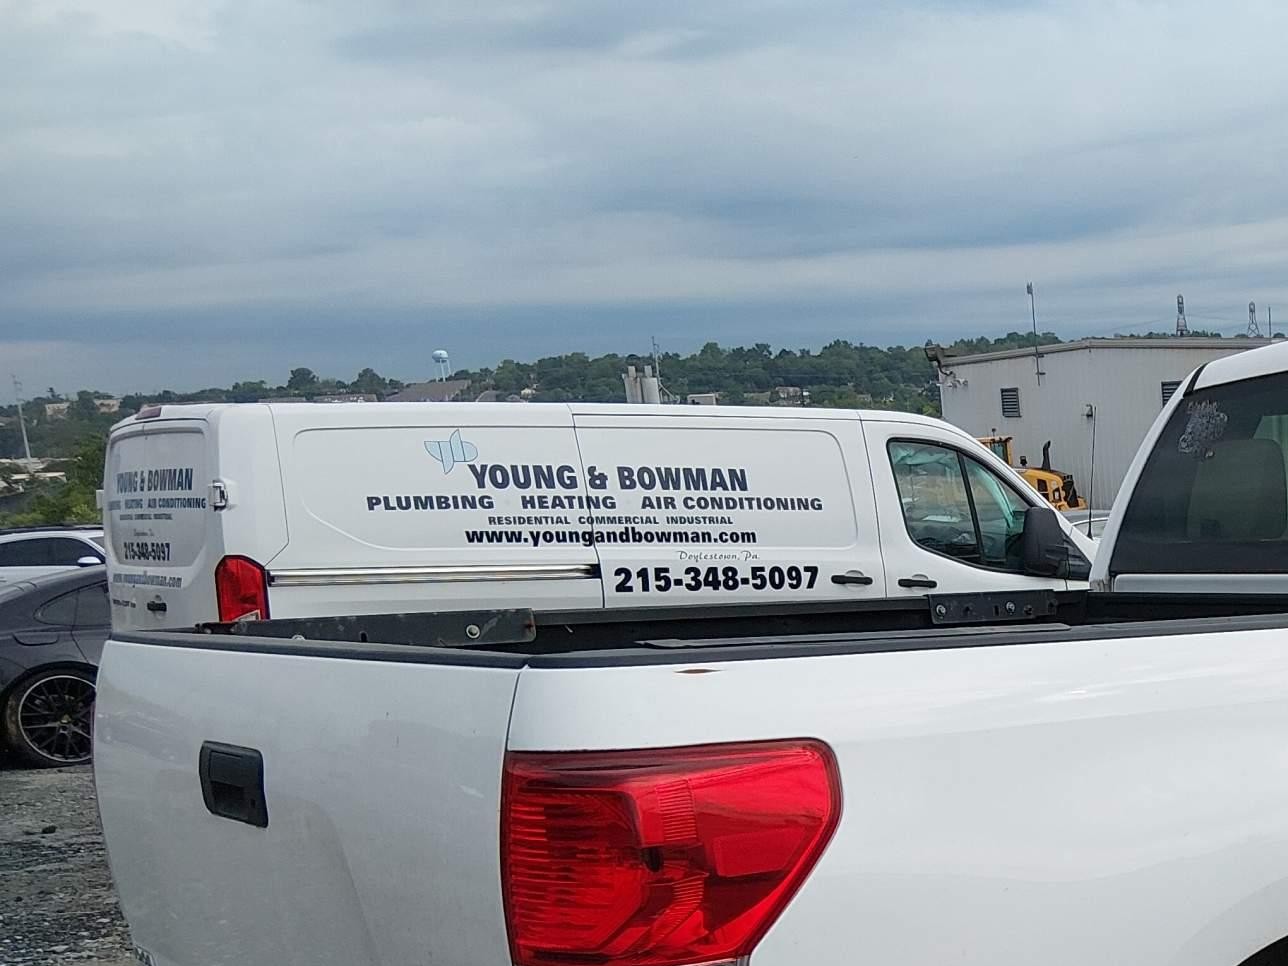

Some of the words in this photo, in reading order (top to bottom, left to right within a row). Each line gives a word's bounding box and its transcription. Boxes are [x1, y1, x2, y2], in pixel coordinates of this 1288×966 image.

[116, 471, 138, 494] YOUNG
[147, 468, 194, 492] BOWMAN
[467, 464, 578, 489] YOUNG
[587, 465, 608, 490] &
[617, 466, 749, 492] BOWMAN
[366, 495, 495, 511] PLUMBING
[521, 495, 617, 510] HEATING
[641, 496, 677, 510] AIR
[683, 496, 823, 511] CONDITIONING
[488, 516, 571, 525] RESIDENTIAL
[578, 516, 659, 525] COMMERCIAL
[666, 516, 734, 525] INDUSTRIAL
[465, 526, 757, 547] www.youngandbowman.com
[613, 565, 819, 593] 215-348-5097
